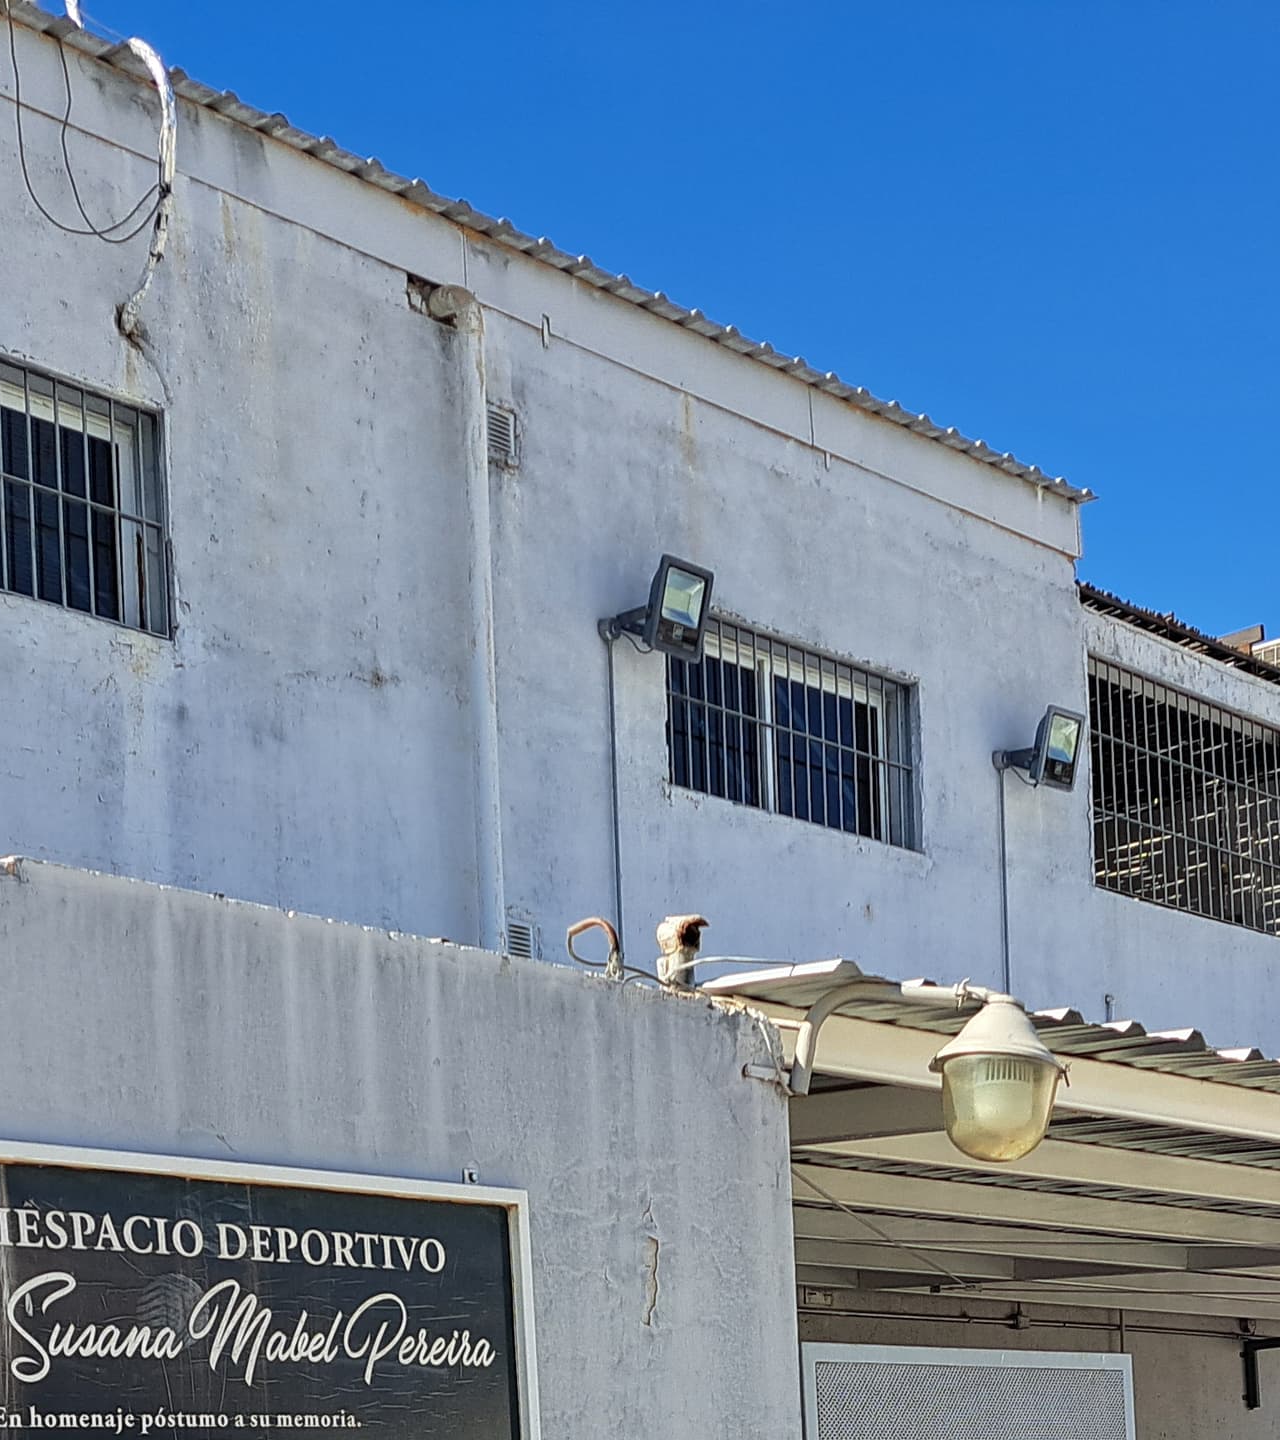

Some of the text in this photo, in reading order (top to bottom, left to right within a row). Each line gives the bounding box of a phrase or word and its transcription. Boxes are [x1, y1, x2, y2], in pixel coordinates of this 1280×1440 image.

[215, 1221, 447, 1274] DEPORTIVO
[7, 1270, 183, 1383] Susana
[188, 1278, 338, 1388] Mabel
[342, 1292, 496, 1386] Pereira
[28, 1407, 133, 1434] homenaje
[141, 1407, 230, 1435] póstumo
[234, 1415, 245, 1428] a
[249, 1414, 272, 1428] su
[276, 1408, 363, 1429] memoria.
